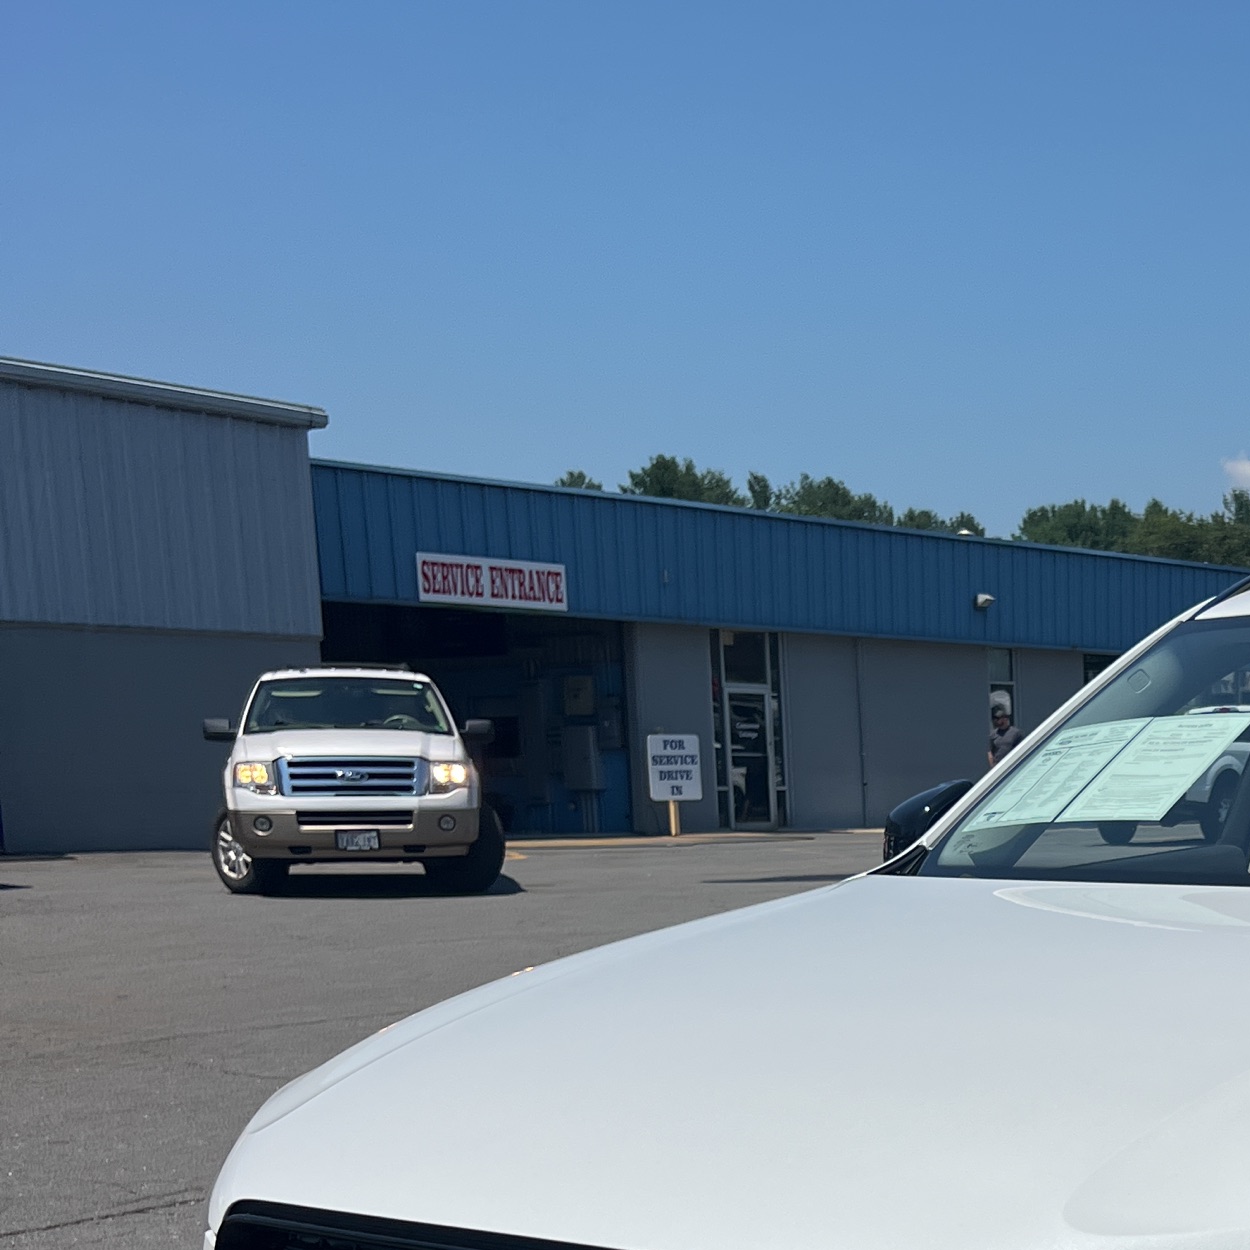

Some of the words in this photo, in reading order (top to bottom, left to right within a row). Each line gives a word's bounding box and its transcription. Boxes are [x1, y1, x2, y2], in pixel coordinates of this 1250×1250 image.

[421, 560, 484, 598] SERVICE
[489, 566, 564, 603] ENTRANCE
[662, 739, 686, 751] FOR
[651, 754, 699, 767] SERVICE
[659, 769, 693, 781] DRIVE
[670, 785, 683, 796] IN
